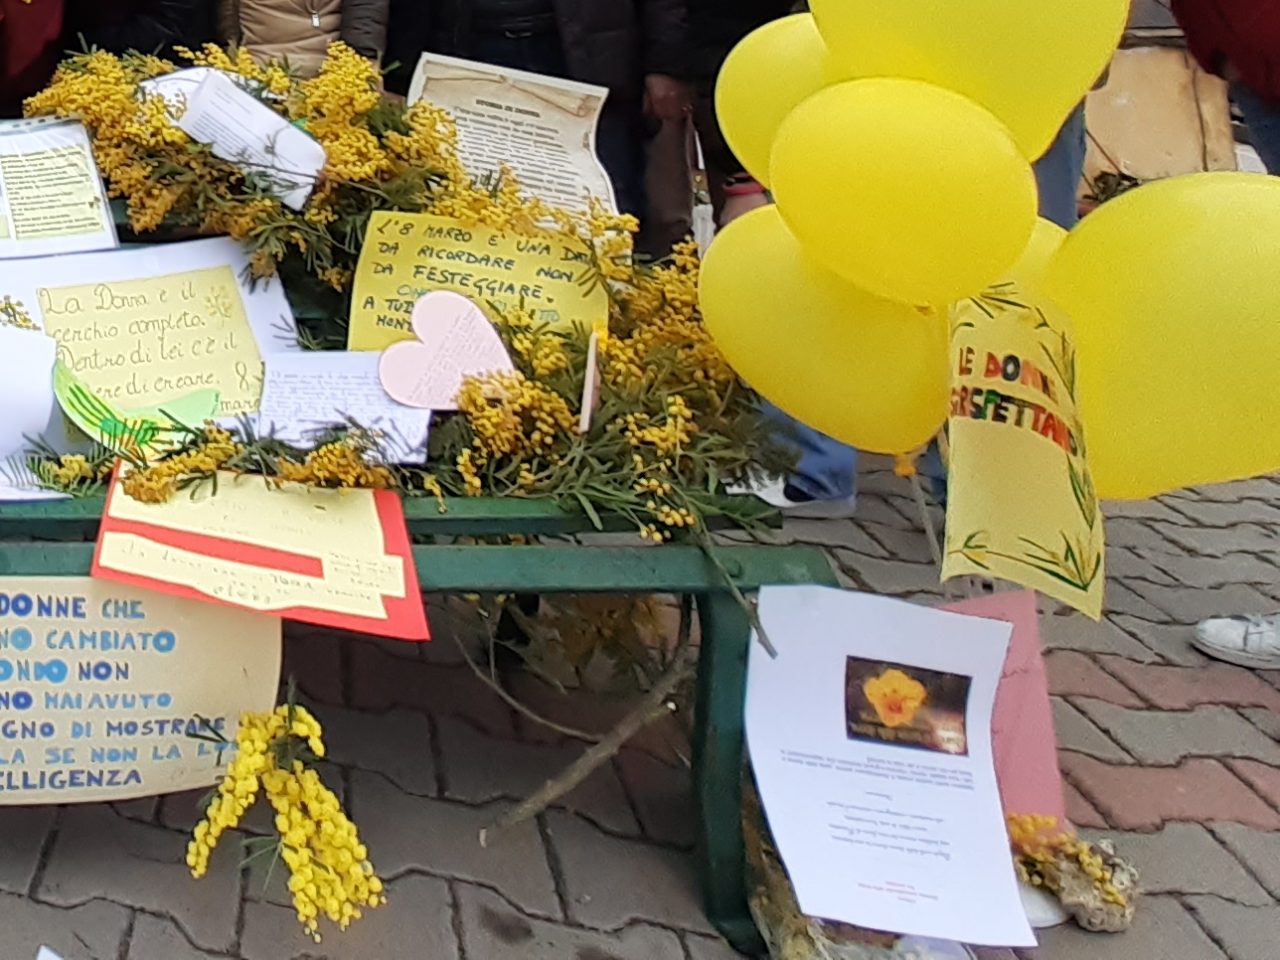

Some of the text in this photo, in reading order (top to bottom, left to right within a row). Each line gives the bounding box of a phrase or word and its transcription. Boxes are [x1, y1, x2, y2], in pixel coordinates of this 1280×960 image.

[377, 218, 415, 236] L'8
[423, 224, 473, 242] MARZO
[516, 240, 551, 256] UNA
[377, 241, 574, 282] DA RICORDARE NON
[372, 261, 394, 275] DA
[412, 265, 555, 303] FESTEGGIARE.
[39, 288, 84, 315] La
[94, 283, 149, 310] Donna
[180, 280, 197, 301] il
[52, 322, 119, 343] cerchio
[58, 345, 126, 373] Dentro
[131, 346, 152, 365] di
[160, 339, 185, 361] lei
[223, 332, 238, 351] il
[959, 346, 975, 377] LE
[126, 371, 149, 395] di
[102, 599, 146, 619] CHE
[46, 629, 176, 653] CAMBIATO
[79, 661, 129, 681] NON
[44, 692, 82, 710] MAI
[88, 693, 172, 710] AVUTO
[71, 721, 92, 739] DI
[45, 746, 76, 765] SE
[91, 746, 138, 764] NON
[152, 742, 182, 761] LA
